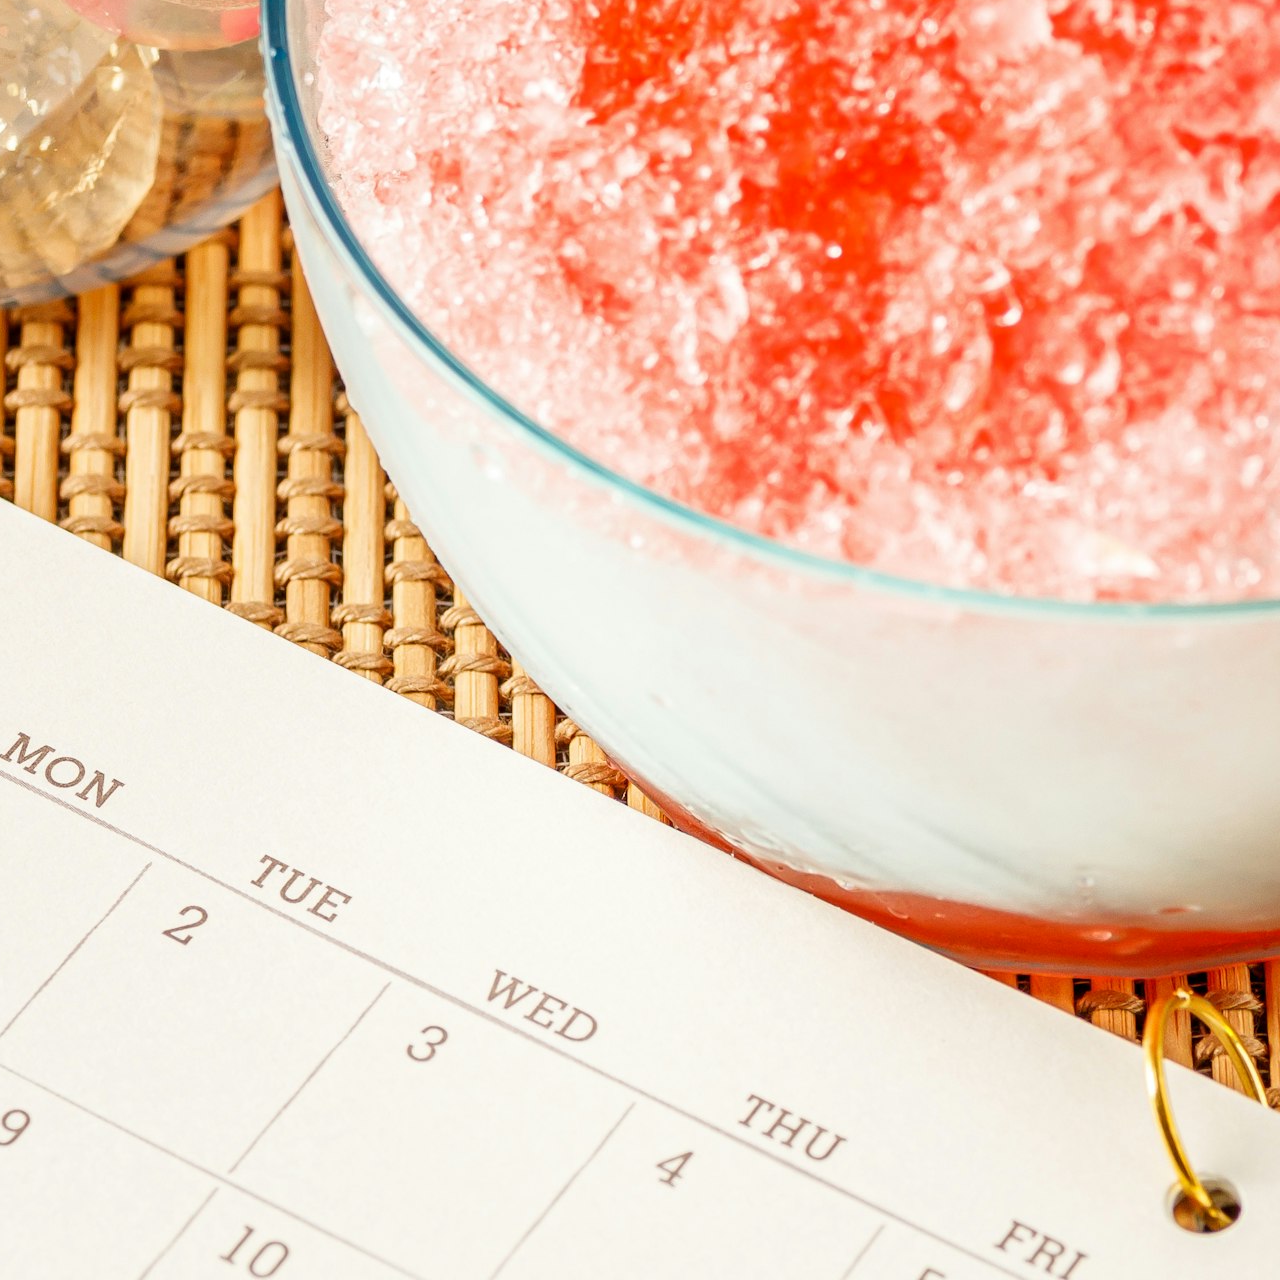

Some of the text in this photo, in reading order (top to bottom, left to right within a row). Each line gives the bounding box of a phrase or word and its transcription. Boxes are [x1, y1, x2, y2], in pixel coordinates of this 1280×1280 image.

[0, 731, 125, 809] MON
[250, 854, 352, 923] TUE
[487, 969, 598, 1042] WED
[738, 1094, 848, 1162] THU
[994, 1220, 1088, 1280] FRI
[161, 905, 208, 946] 2
[406, 1025, 448, 1062] 3
[656, 1151, 694, 1188] 4
[219, 1225, 290, 1280] 10
